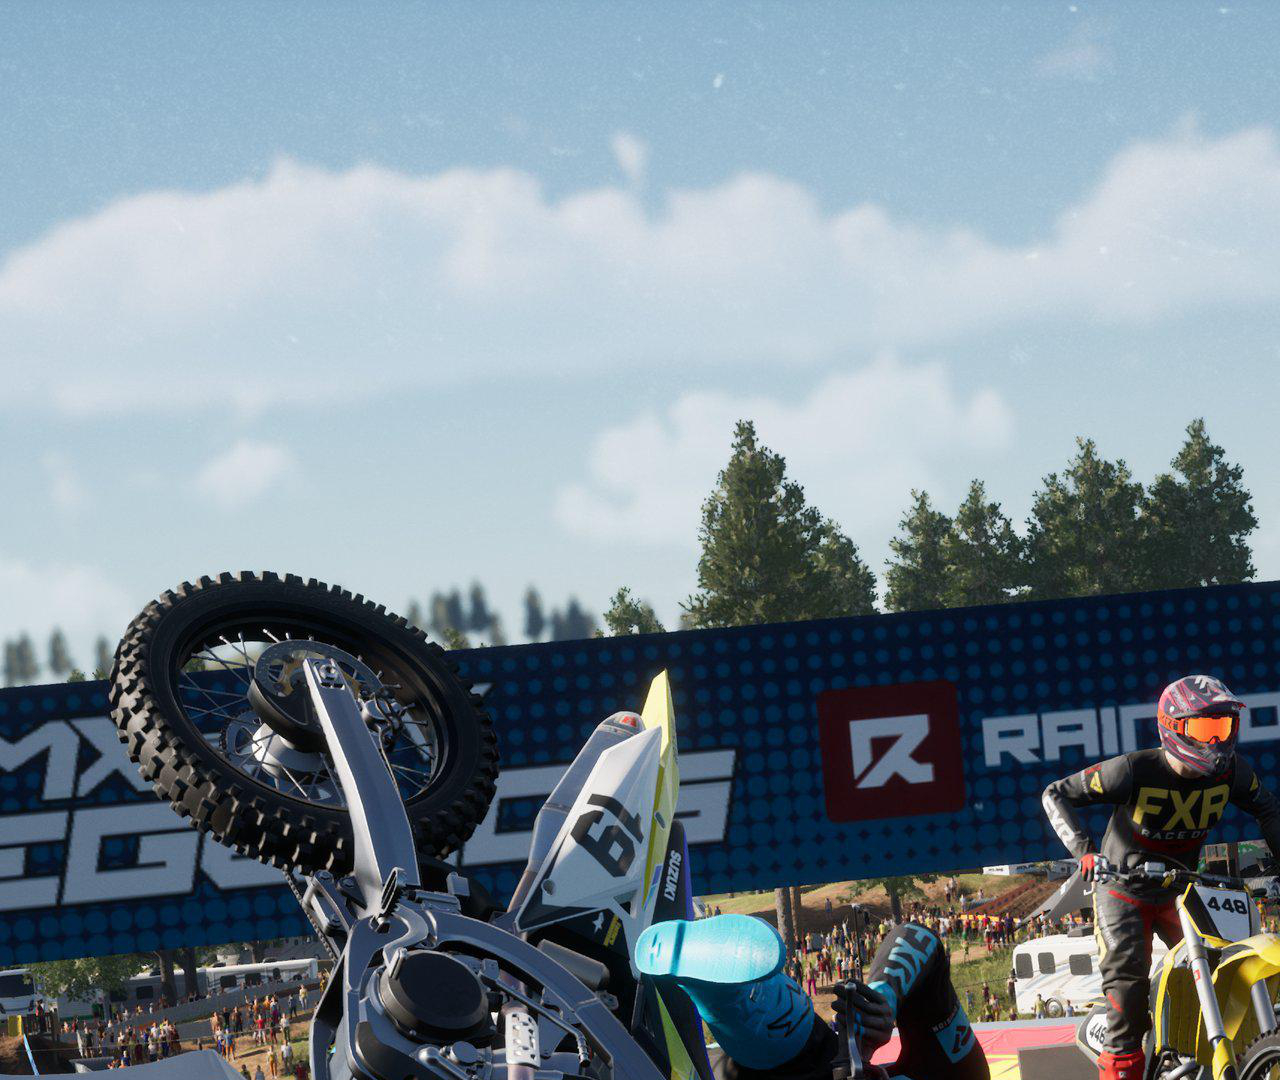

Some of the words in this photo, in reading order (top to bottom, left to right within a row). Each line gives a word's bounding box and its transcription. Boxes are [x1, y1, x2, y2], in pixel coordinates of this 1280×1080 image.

[1132, 783, 1231, 831] FXR
[570, 793, 645, 878] 19
[1141, 829, 1189, 840] RACE
[664, 850, 683, 902] SUZUKI
[1207, 896, 1248, 915] 448
